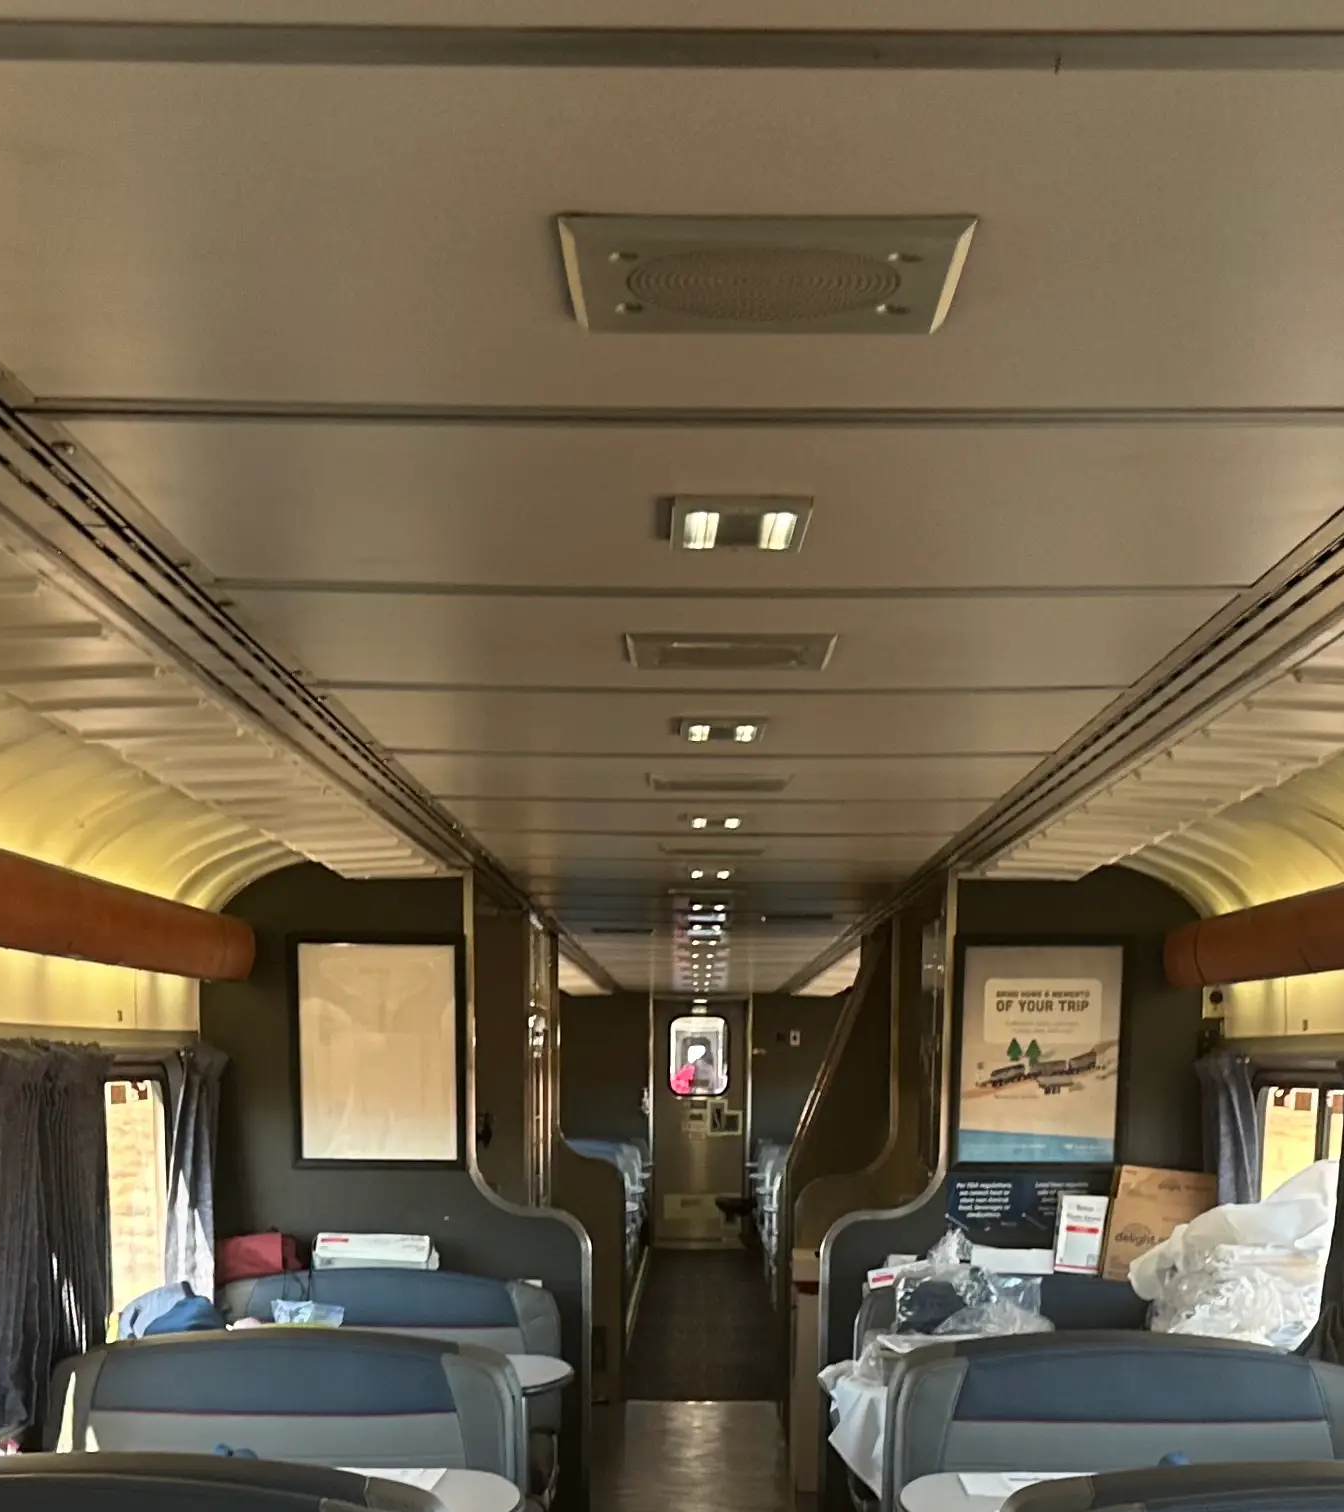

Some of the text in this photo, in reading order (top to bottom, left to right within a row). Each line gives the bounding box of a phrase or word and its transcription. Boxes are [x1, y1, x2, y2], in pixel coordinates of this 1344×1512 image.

[996, 1000, 1089, 1012] OF YOUR TRIP
